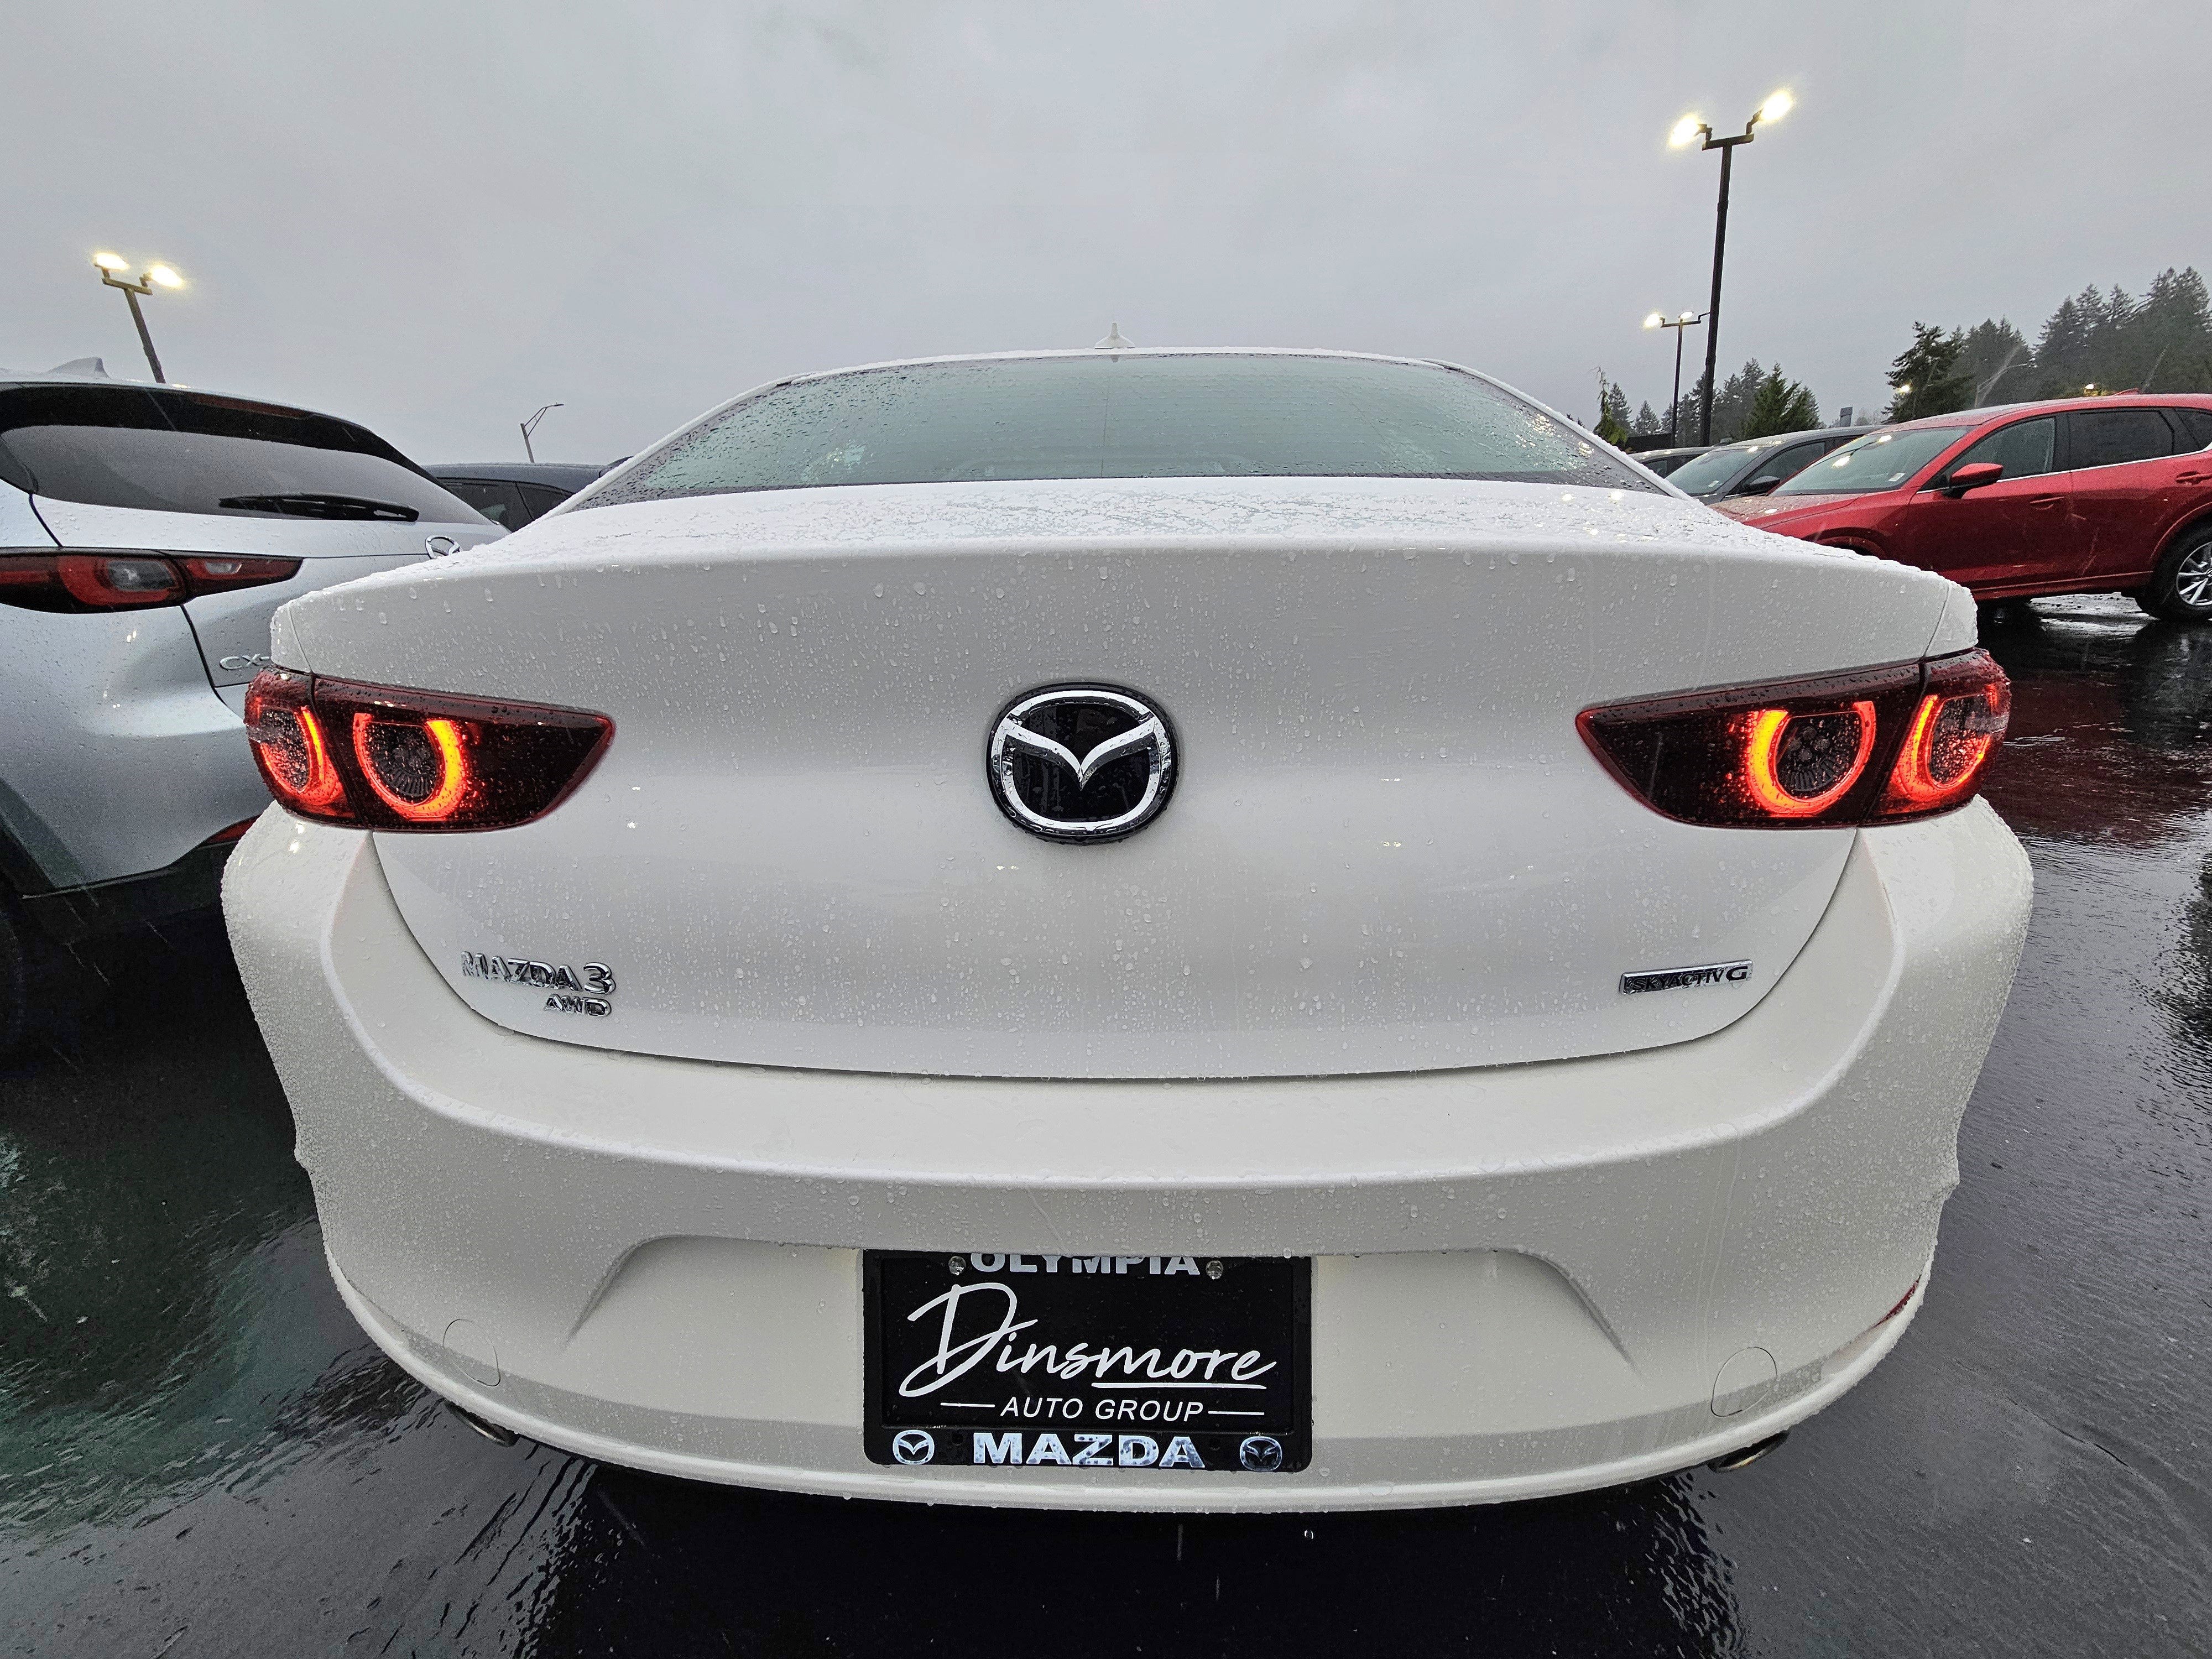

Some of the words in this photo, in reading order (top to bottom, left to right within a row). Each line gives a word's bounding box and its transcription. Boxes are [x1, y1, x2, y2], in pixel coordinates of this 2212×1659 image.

[1632, 969, 1725, 992] SKYACTIV
[544, 994, 612, 1017] AWD
[971, 1253, 1200, 1275] OLYMPIA
[899, 1282, 1277, 1397] Dinsmore
[1000, 1396, 1083, 1419] AUTO
[1095, 1400, 1204, 1422] GROUP
[973, 1432, 1206, 1468] MAZDA
